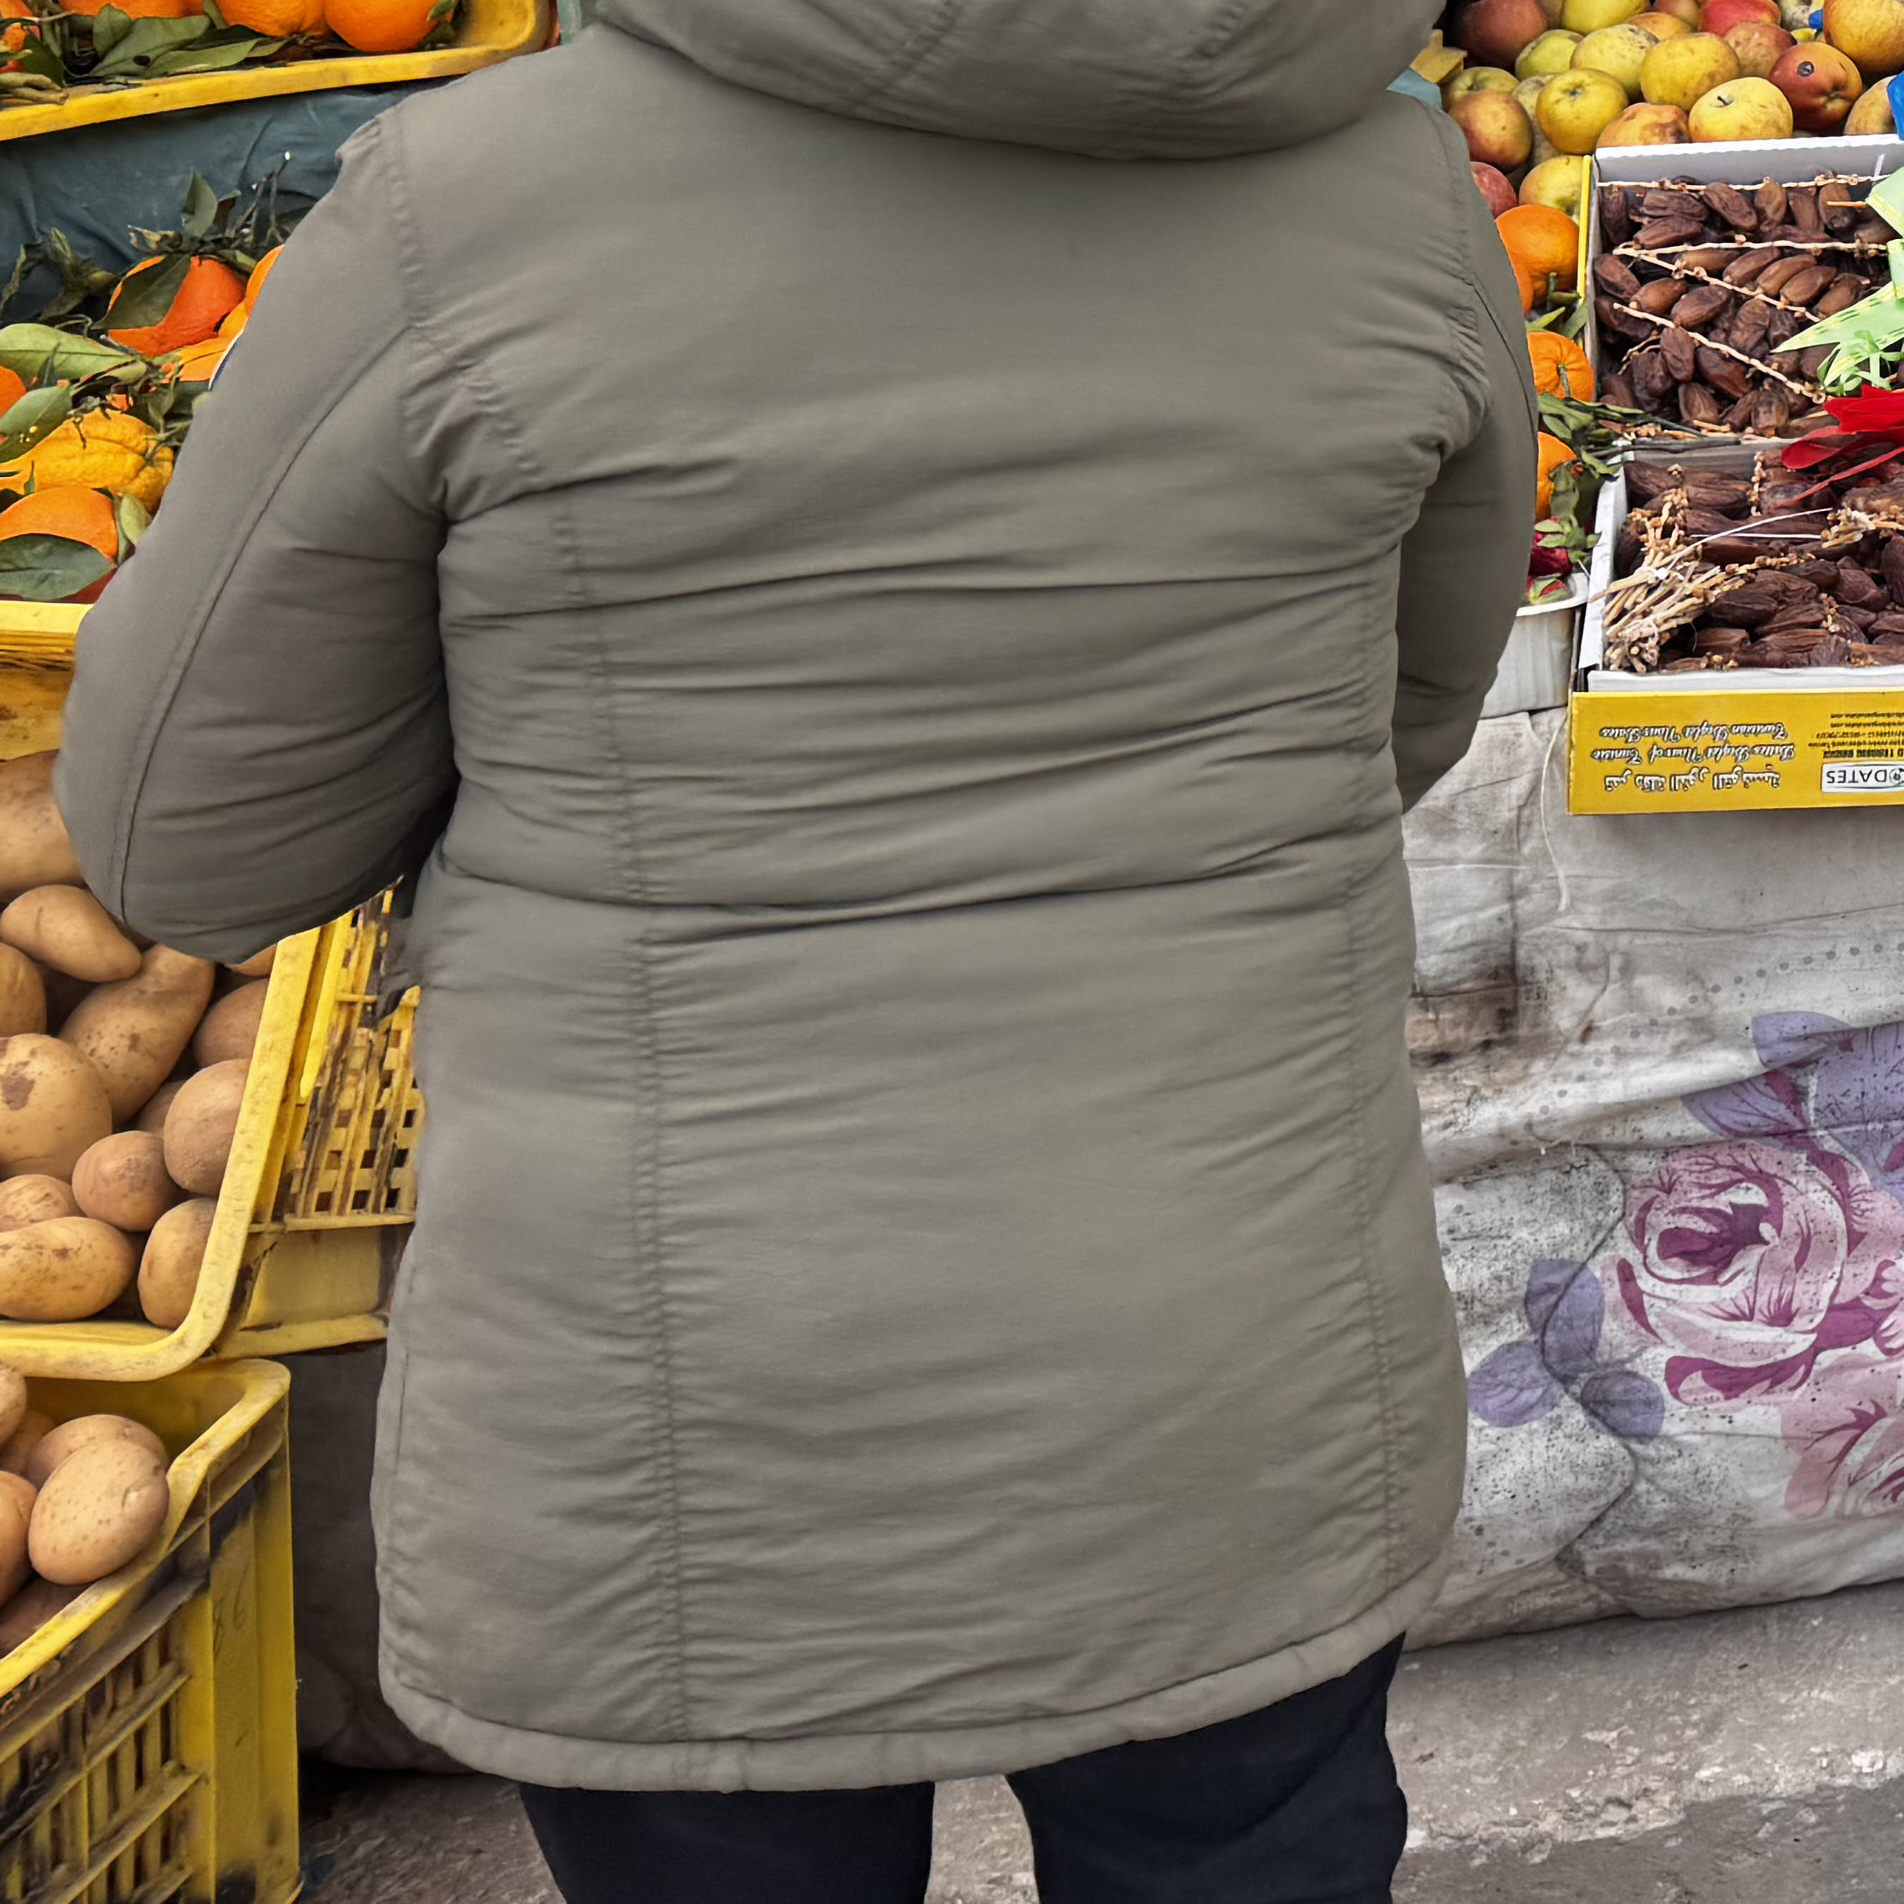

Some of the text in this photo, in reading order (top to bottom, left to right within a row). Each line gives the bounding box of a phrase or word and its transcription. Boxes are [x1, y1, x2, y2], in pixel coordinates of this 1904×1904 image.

[1604, 764, 1780, 794] تمر دقلة النور التونسية
